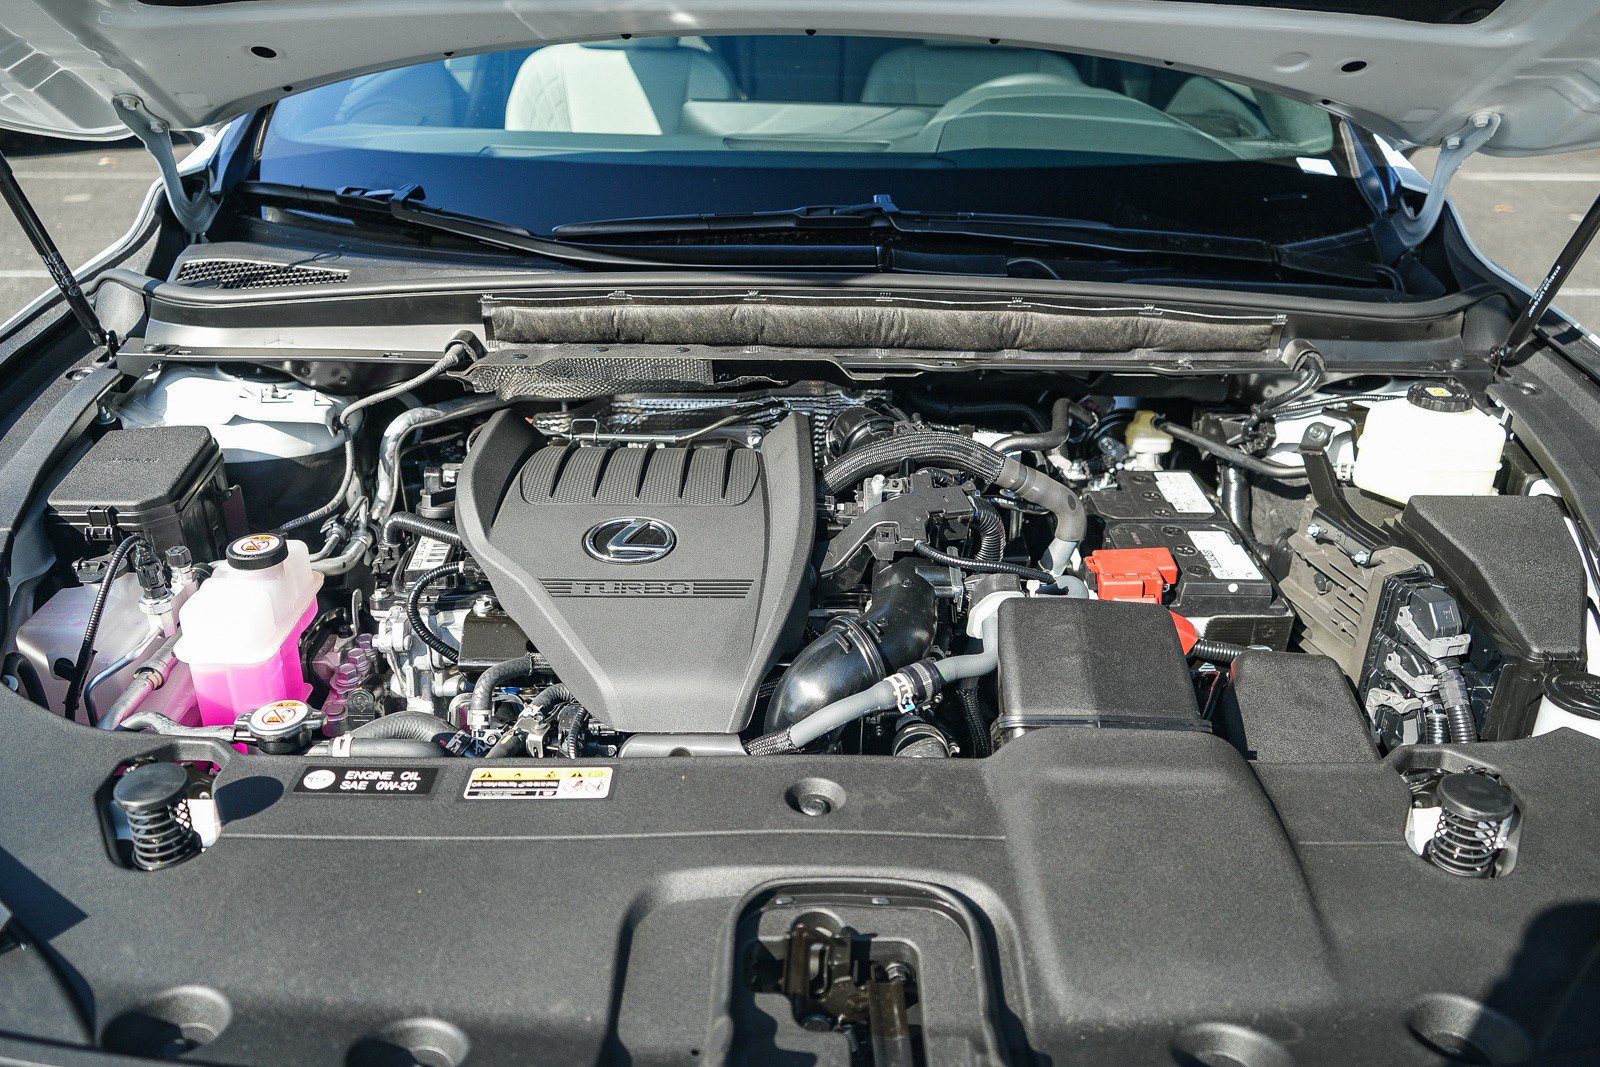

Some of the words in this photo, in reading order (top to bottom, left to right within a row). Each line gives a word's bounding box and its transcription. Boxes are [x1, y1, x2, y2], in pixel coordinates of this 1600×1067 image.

[576, 582, 690, 595] TURBO
[344, 770, 395, 781] ENGINE
[400, 771, 421, 781] OIL
[339, 780, 369, 790] SAE
[375, 781, 418, 791] 0W-20
